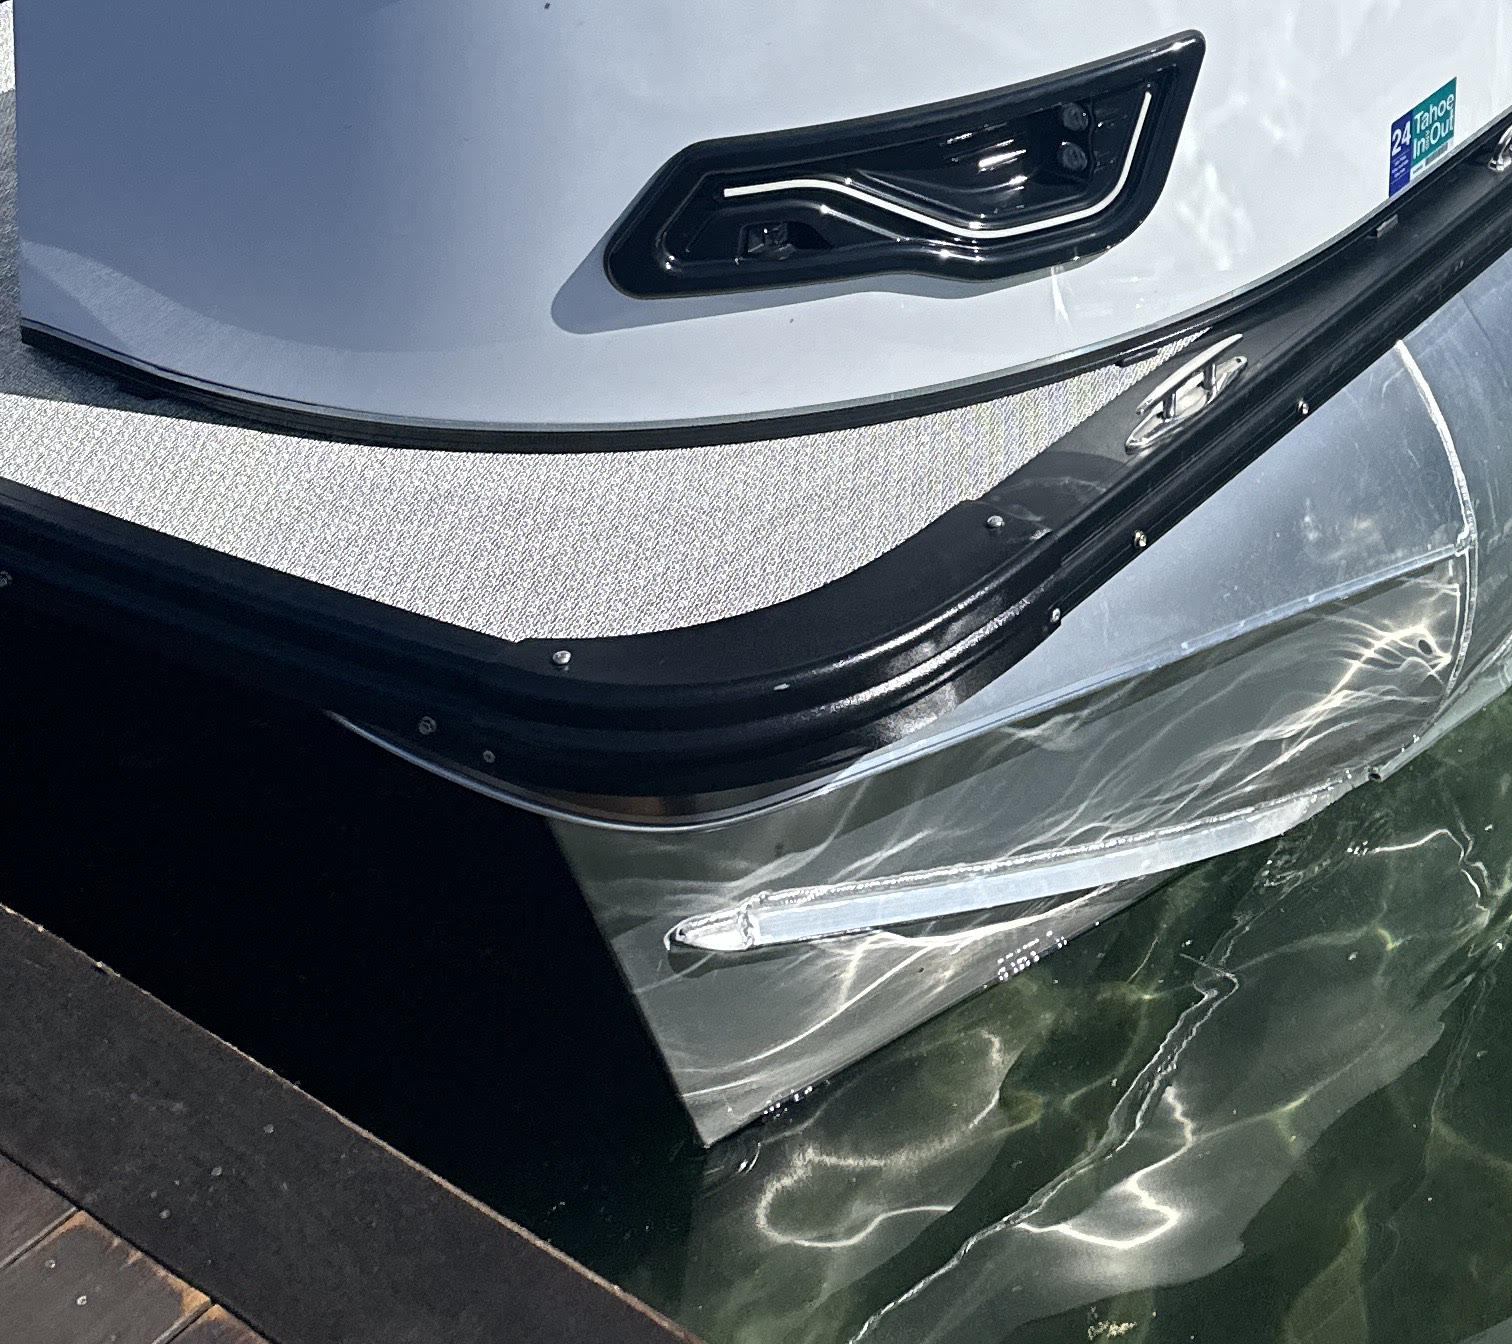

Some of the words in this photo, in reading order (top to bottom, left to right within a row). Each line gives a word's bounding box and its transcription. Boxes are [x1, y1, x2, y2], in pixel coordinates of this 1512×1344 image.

[1413, 94, 1455, 134] Tahoe
[1391, 120, 1411, 157] 24
[1412, 137, 1426, 160] In
[1429, 109, 1455, 144] Out
